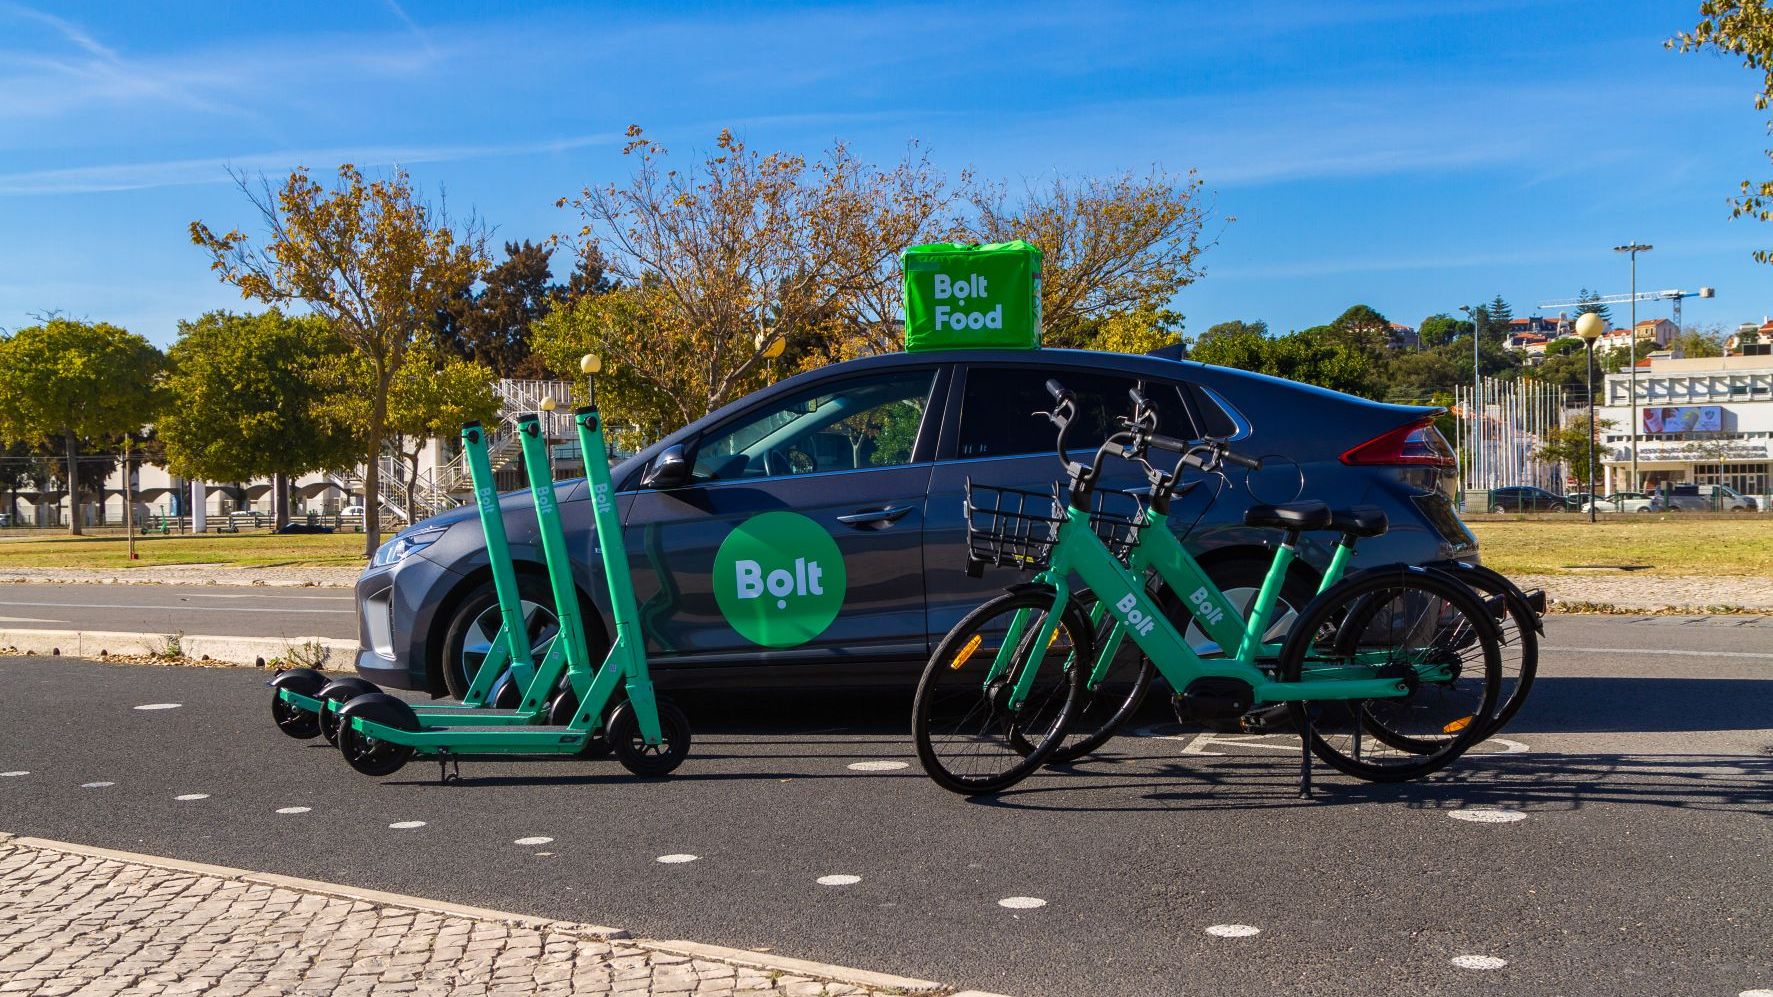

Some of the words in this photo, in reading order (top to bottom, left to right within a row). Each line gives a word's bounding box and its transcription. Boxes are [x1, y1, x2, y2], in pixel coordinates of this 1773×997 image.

[934, 273, 988, 306] Bolt
[935, 304, 1003, 331] Food
[479, 487, 496, 513] Bolt
[536, 486, 552, 514] Bolt
[594, 483, 612, 513] Bolt
[735, 557, 824, 610] Bolt
[1115, 592, 1156, 637] Bolt
[1189, 586, 1224, 626] Bolt
